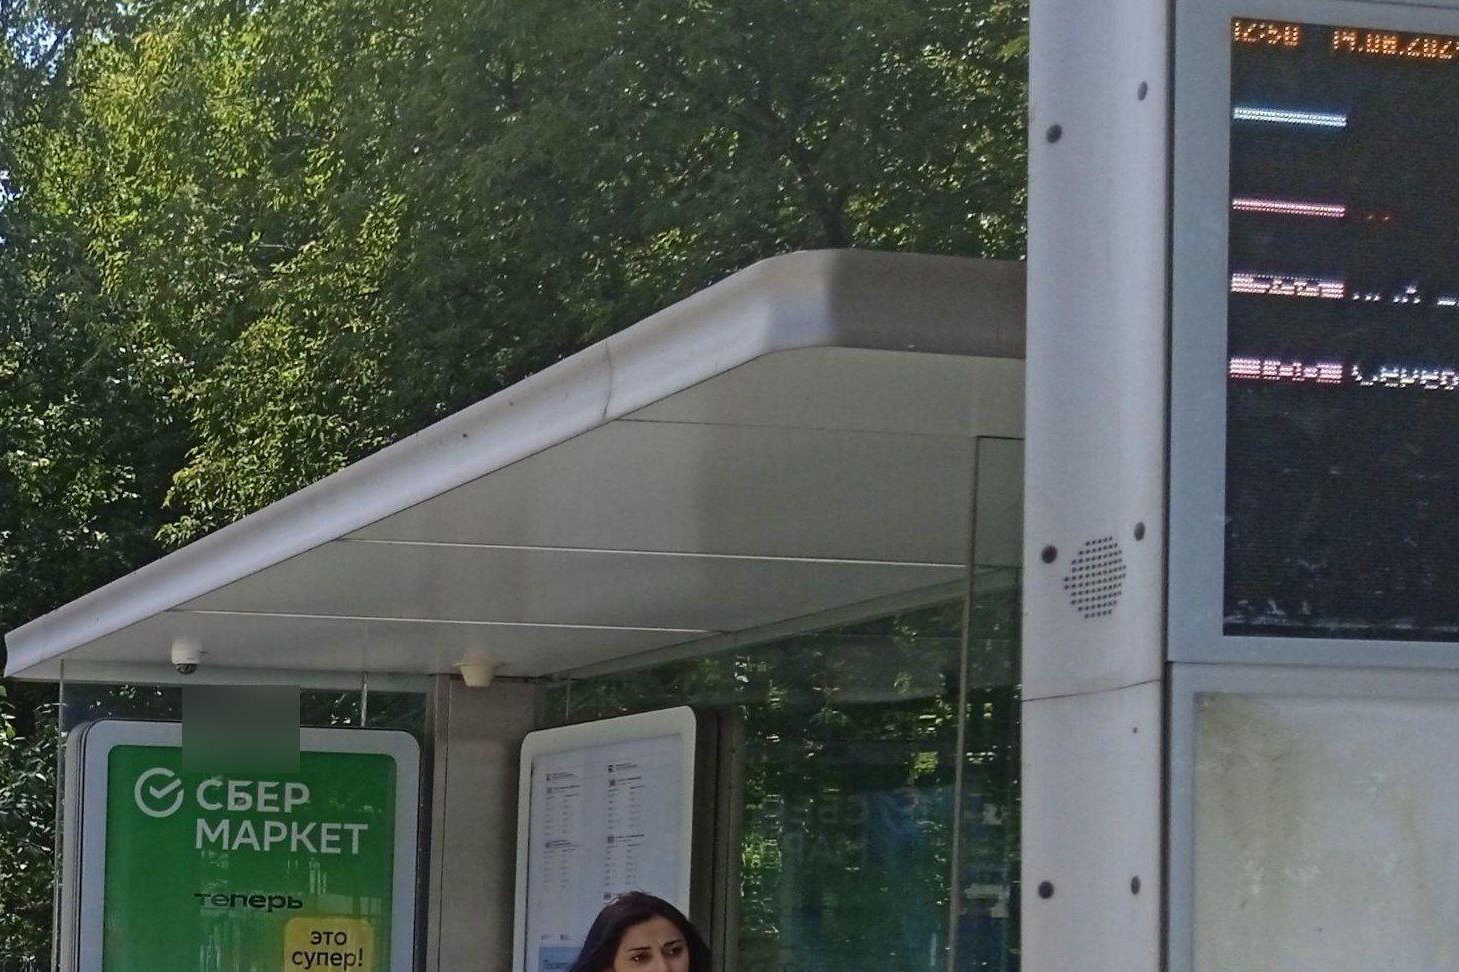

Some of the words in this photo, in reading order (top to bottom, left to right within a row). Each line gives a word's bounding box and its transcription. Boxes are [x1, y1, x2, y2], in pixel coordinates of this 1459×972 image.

[196, 778, 310, 813] СБЕР
[195, 817, 369, 855] МАРКЕТ
[193, 892, 304, 913] теперь
[309, 930, 348, 946] это
[291, 948, 364, 971] супер!
